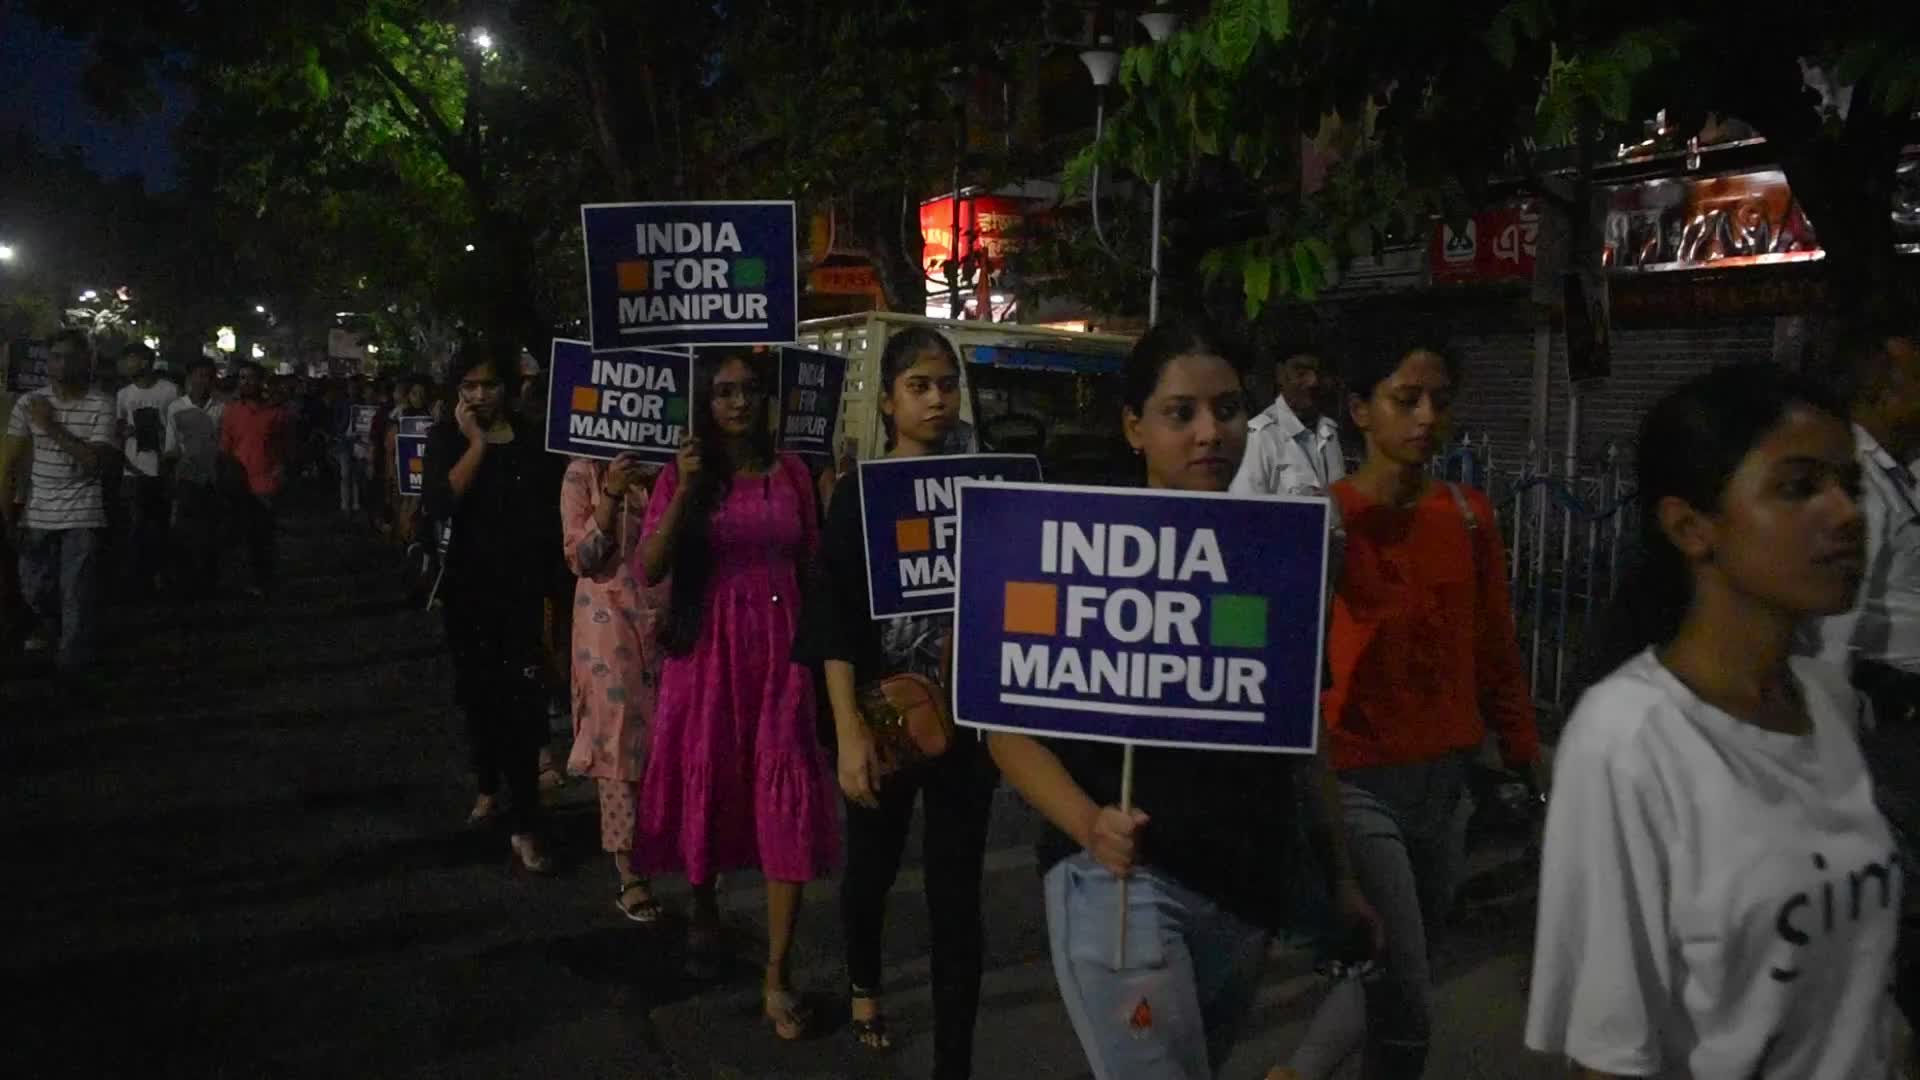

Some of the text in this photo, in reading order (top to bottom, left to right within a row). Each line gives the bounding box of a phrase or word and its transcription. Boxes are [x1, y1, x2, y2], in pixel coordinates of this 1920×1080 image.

[635, 221, 742, 255] INDIA
[652, 256, 729, 290] FOR
[618, 293, 768, 324] MANIPUR
[590, 359, 676, 392] INDIA
[600, 389, 664, 420] FOR
[1040, 519, 1228, 583] INDIA
[1065, 584, 1201, 646] FOR
[1000, 641, 1267, 705] MANIPUR
